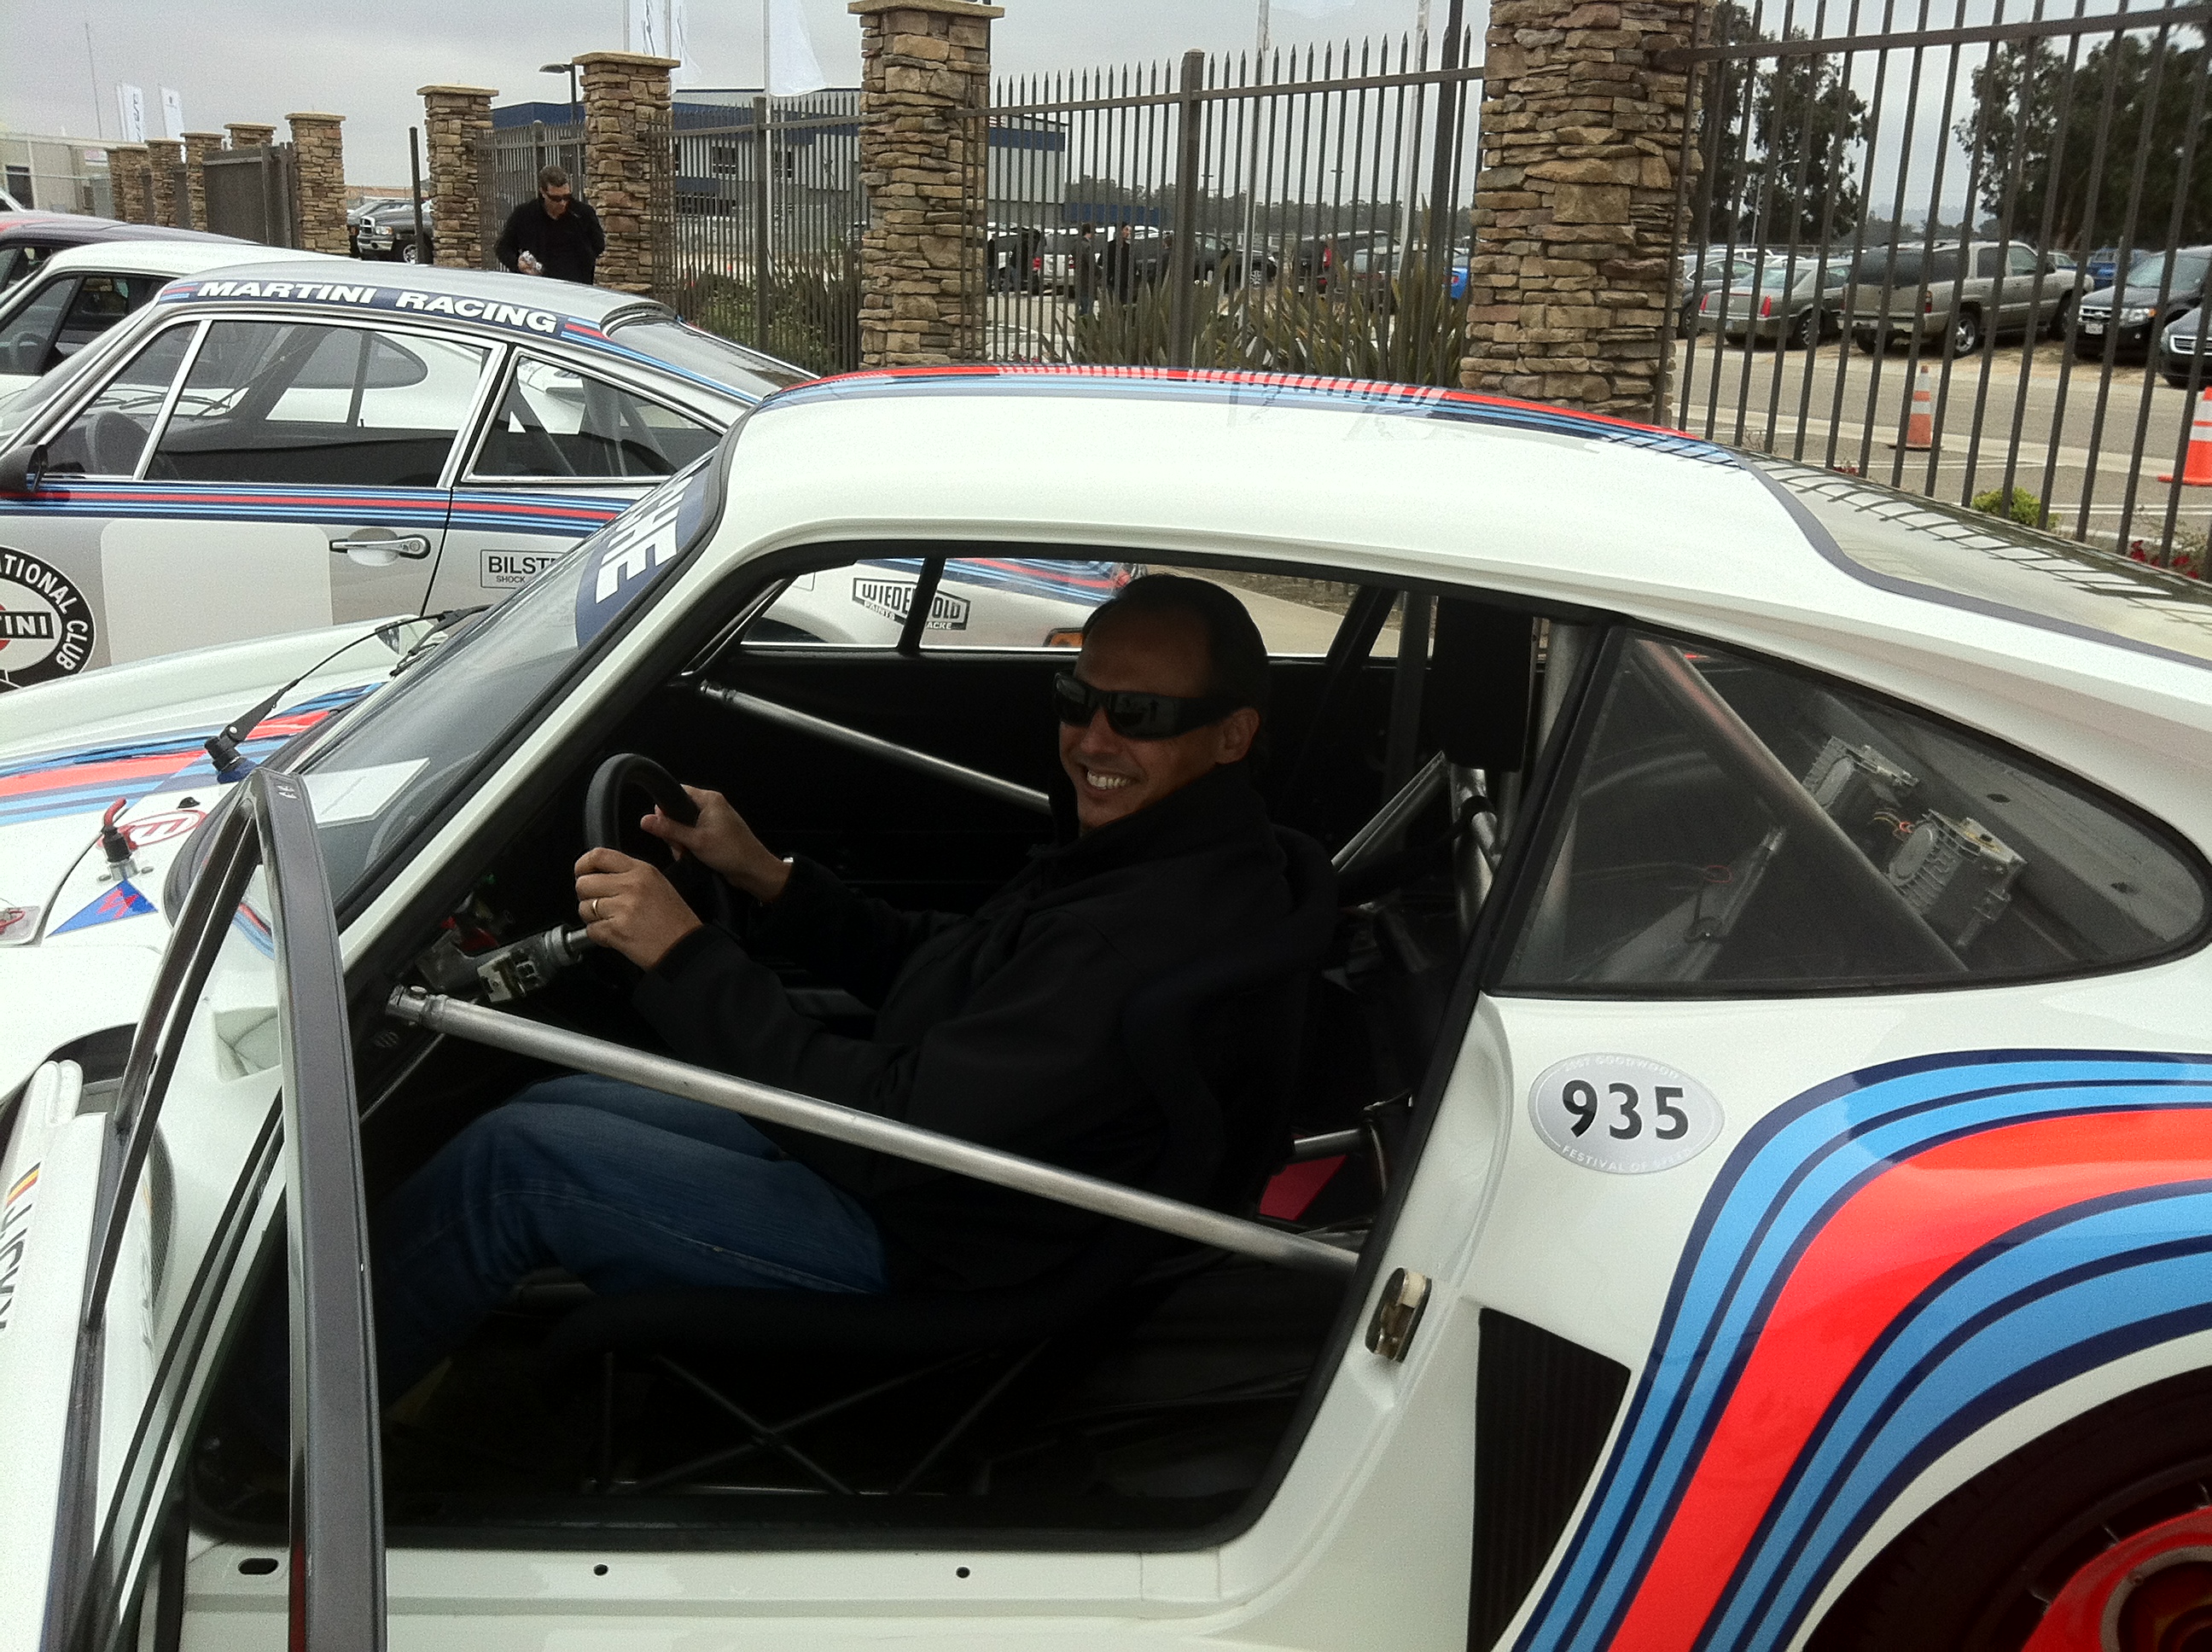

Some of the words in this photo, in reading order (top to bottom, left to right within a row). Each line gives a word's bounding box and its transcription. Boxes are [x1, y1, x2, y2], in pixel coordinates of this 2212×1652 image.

[197, 281, 377, 304] MARTINI
[395, 291, 557, 334] RACING
[488, 556, 556, 574] BILST
[926, 621, 952, 630] ACKE
[55, 620, 89, 672] CLUB
[1562, 1079, 1689, 1141] 935
[1562, 1144, 1624, 1172] FESTIVAL
[1629, 1161, 1646, 1172] OF
